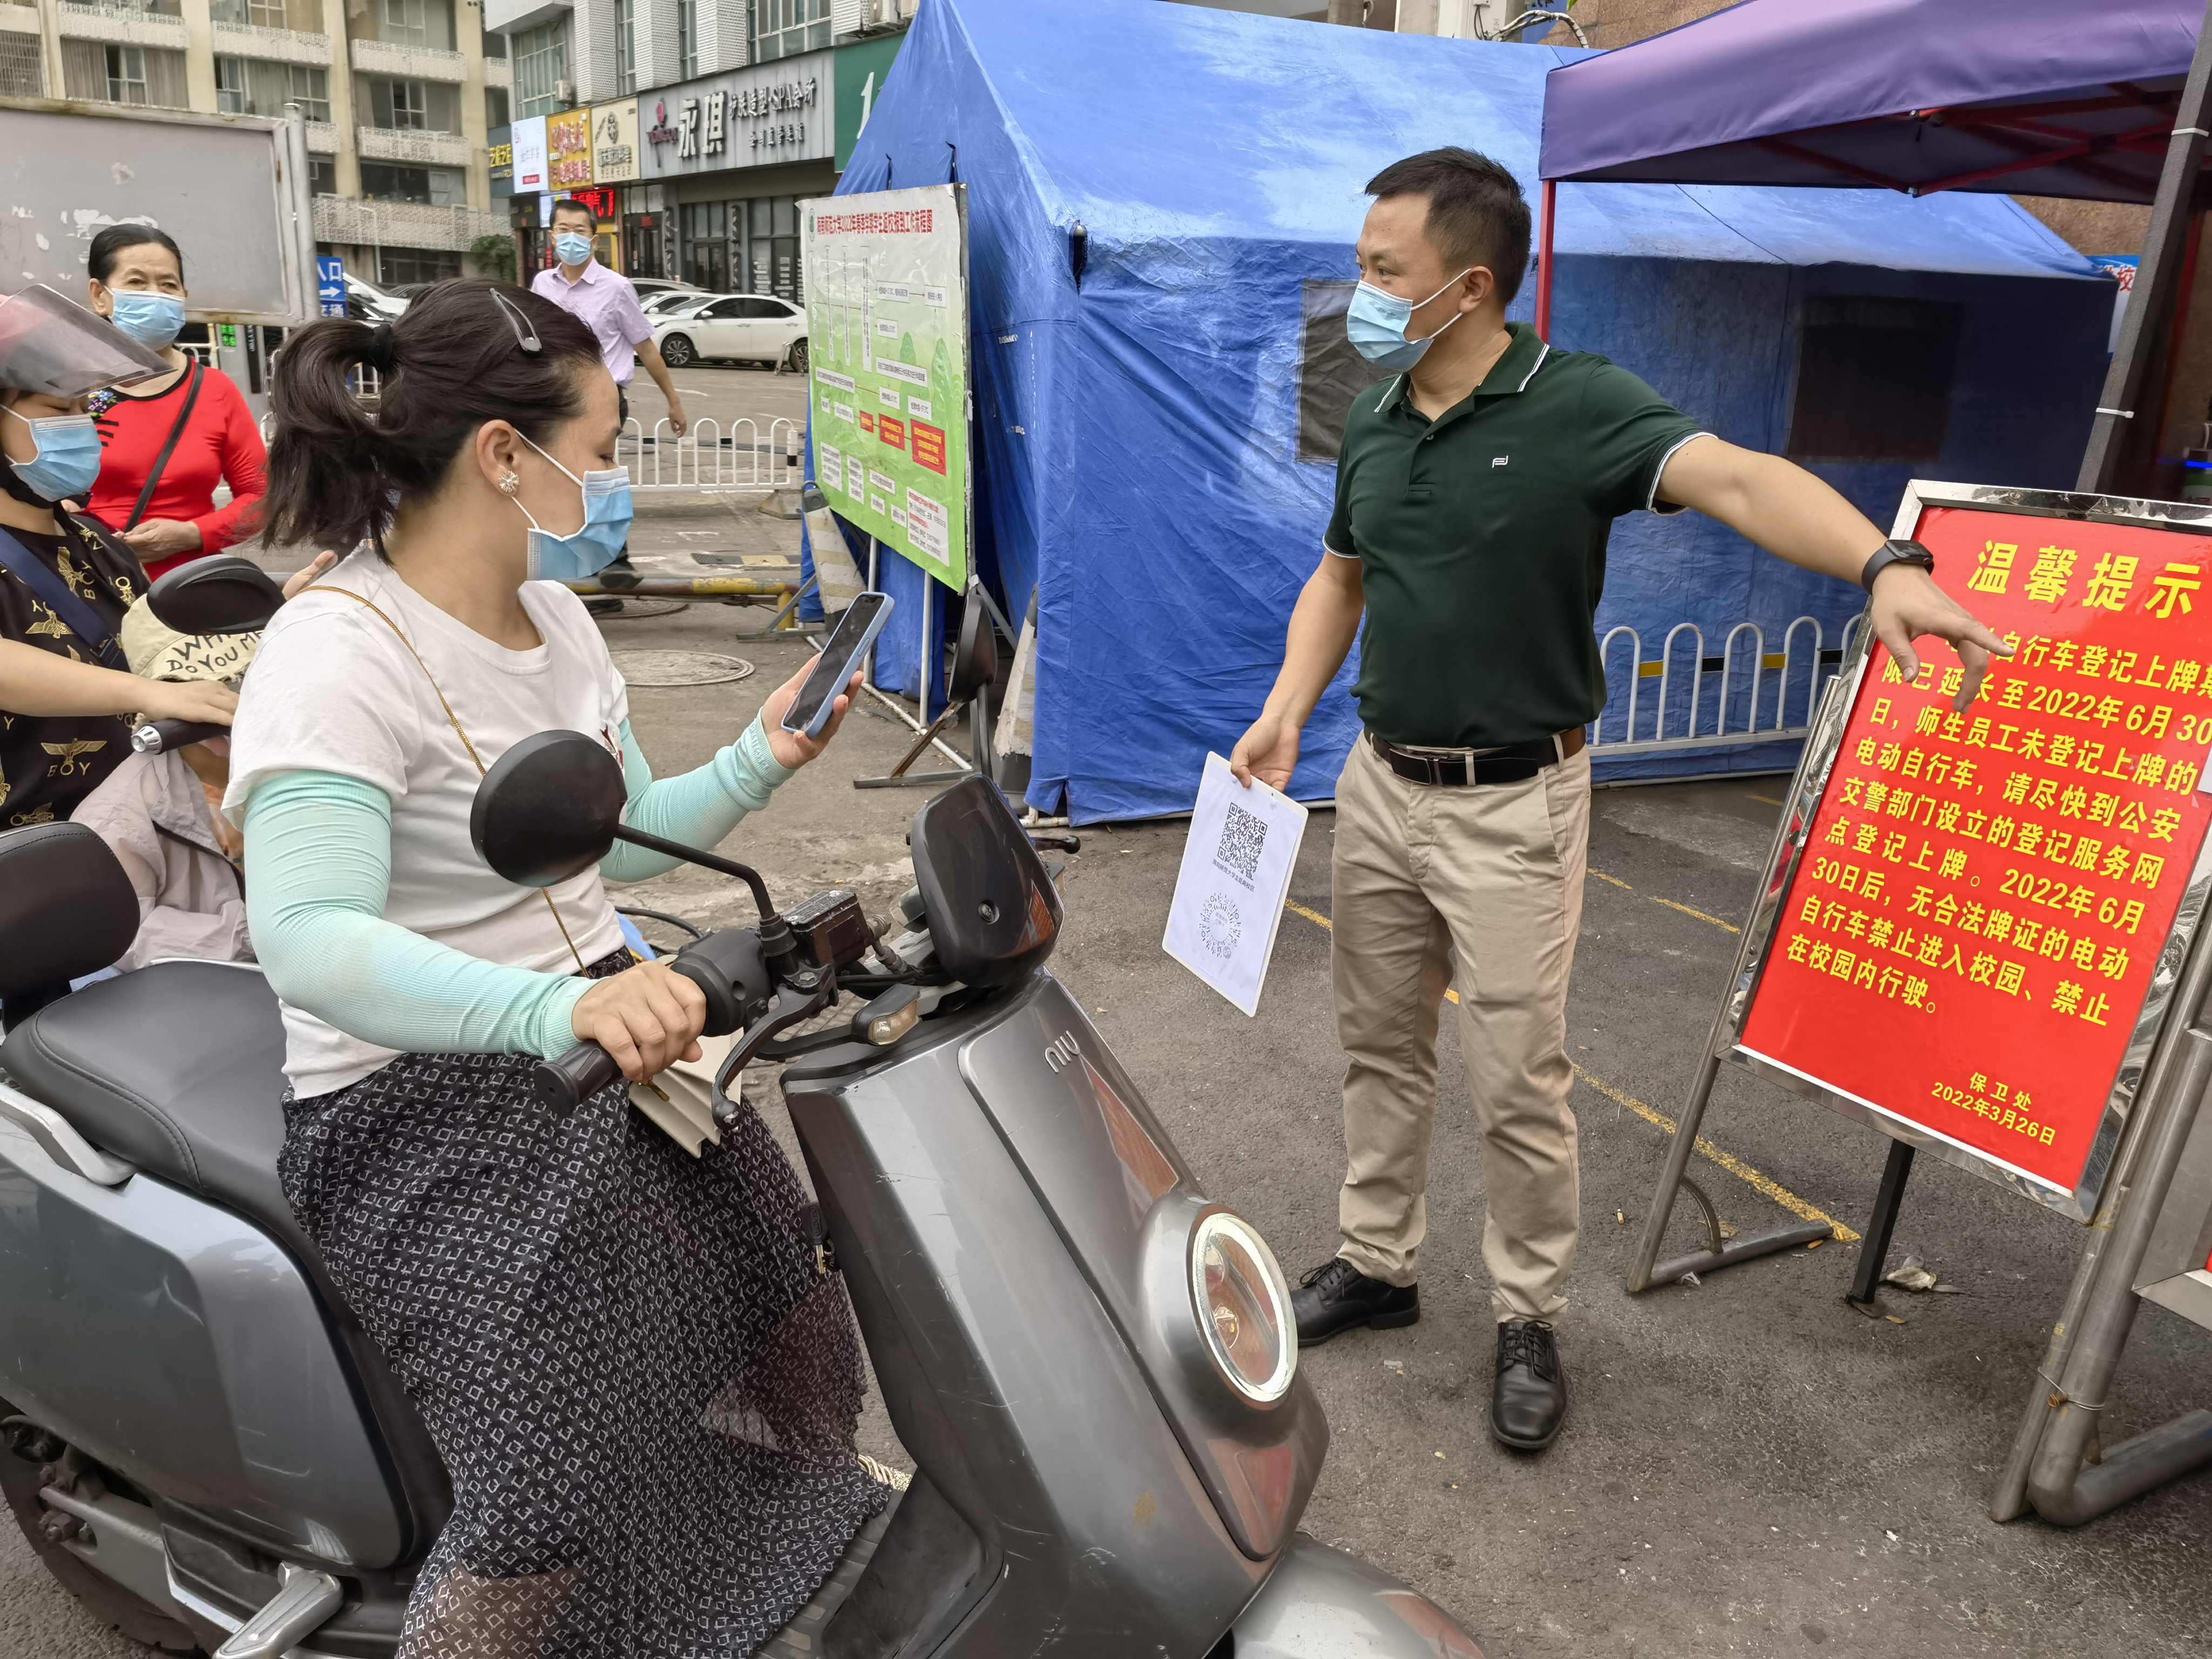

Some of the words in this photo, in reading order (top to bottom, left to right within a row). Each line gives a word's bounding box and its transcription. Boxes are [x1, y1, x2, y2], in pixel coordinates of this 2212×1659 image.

[678, 91, 727, 158] 永琪
[1967, 540, 2201, 619] 温馨提示
[198, 646, 239, 673] YOU
[1945, 626, 2212, 699] 自行车登记上牌
[47, 761, 91, 777] BOY
[1870, 698, 2198, 795] 日，师生员工未登记上牌的
[1856, 737, 2182, 843] 电动自行车，请尽快到公安
[1839, 777, 2165, 889] 交警部门设立的登记服务网
[1812, 857, 2129, 980] 30日后，无合法牌证的电动
[1788, 934, 1935, 1013] 在校园内行驶。
[1800, 894, 2110, 1026] 自行车禁止进入校园、禁止
[1932, 1082, 2055, 1146] 2022年3月26日
[1970, 1072, 2032, 1112] 保卫处
